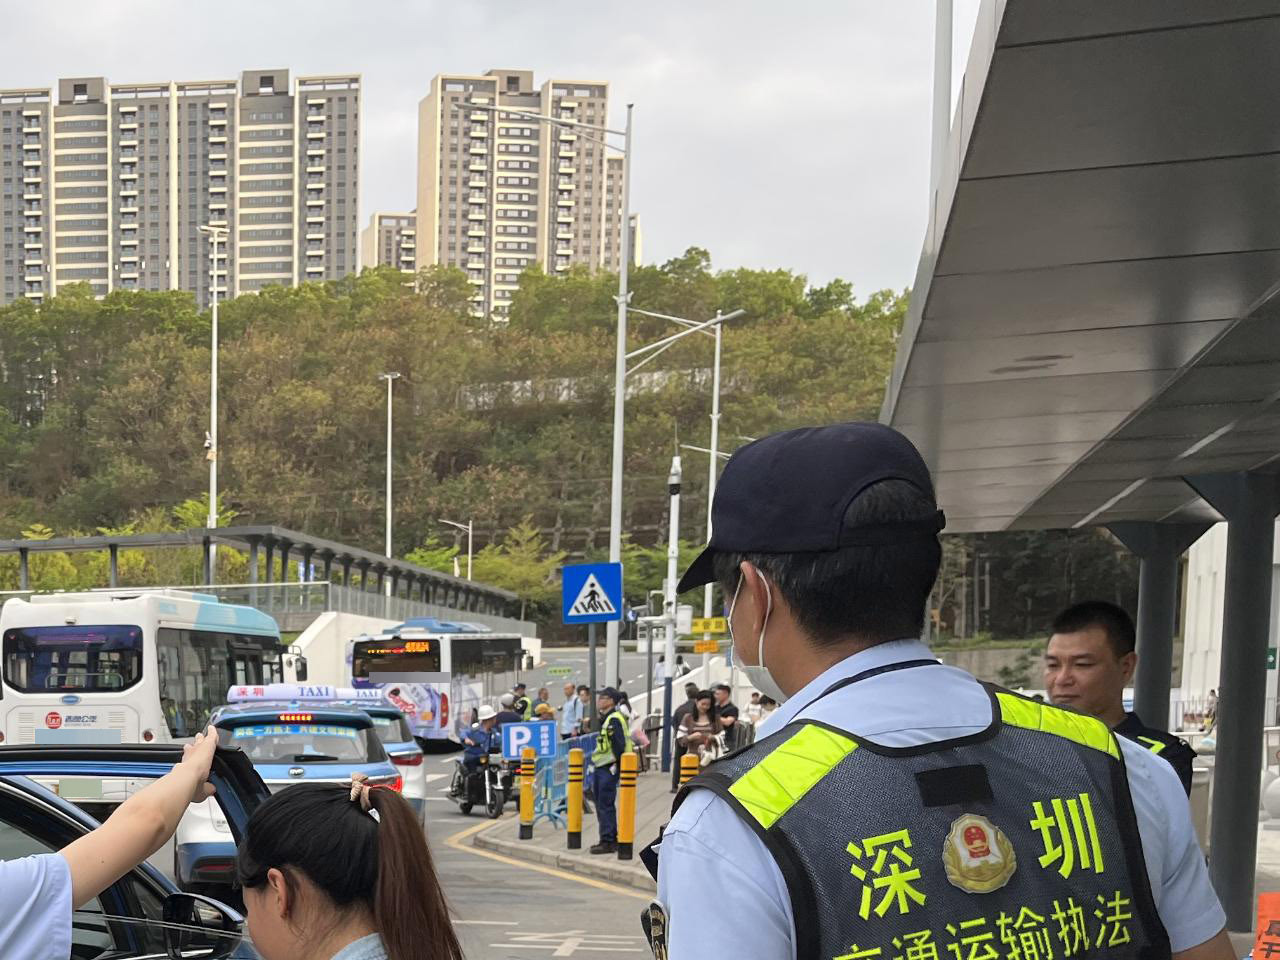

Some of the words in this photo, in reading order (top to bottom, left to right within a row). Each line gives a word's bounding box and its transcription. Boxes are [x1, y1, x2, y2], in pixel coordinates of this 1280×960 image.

[237, 687, 264, 697] 深圳
[298, 686, 329, 697] TAXI
[356, 690, 380, 698] TAXI
[509, 726, 531, 756] P
[846, 828, 927, 921] 深
[1030, 793, 1104, 879] 圳
